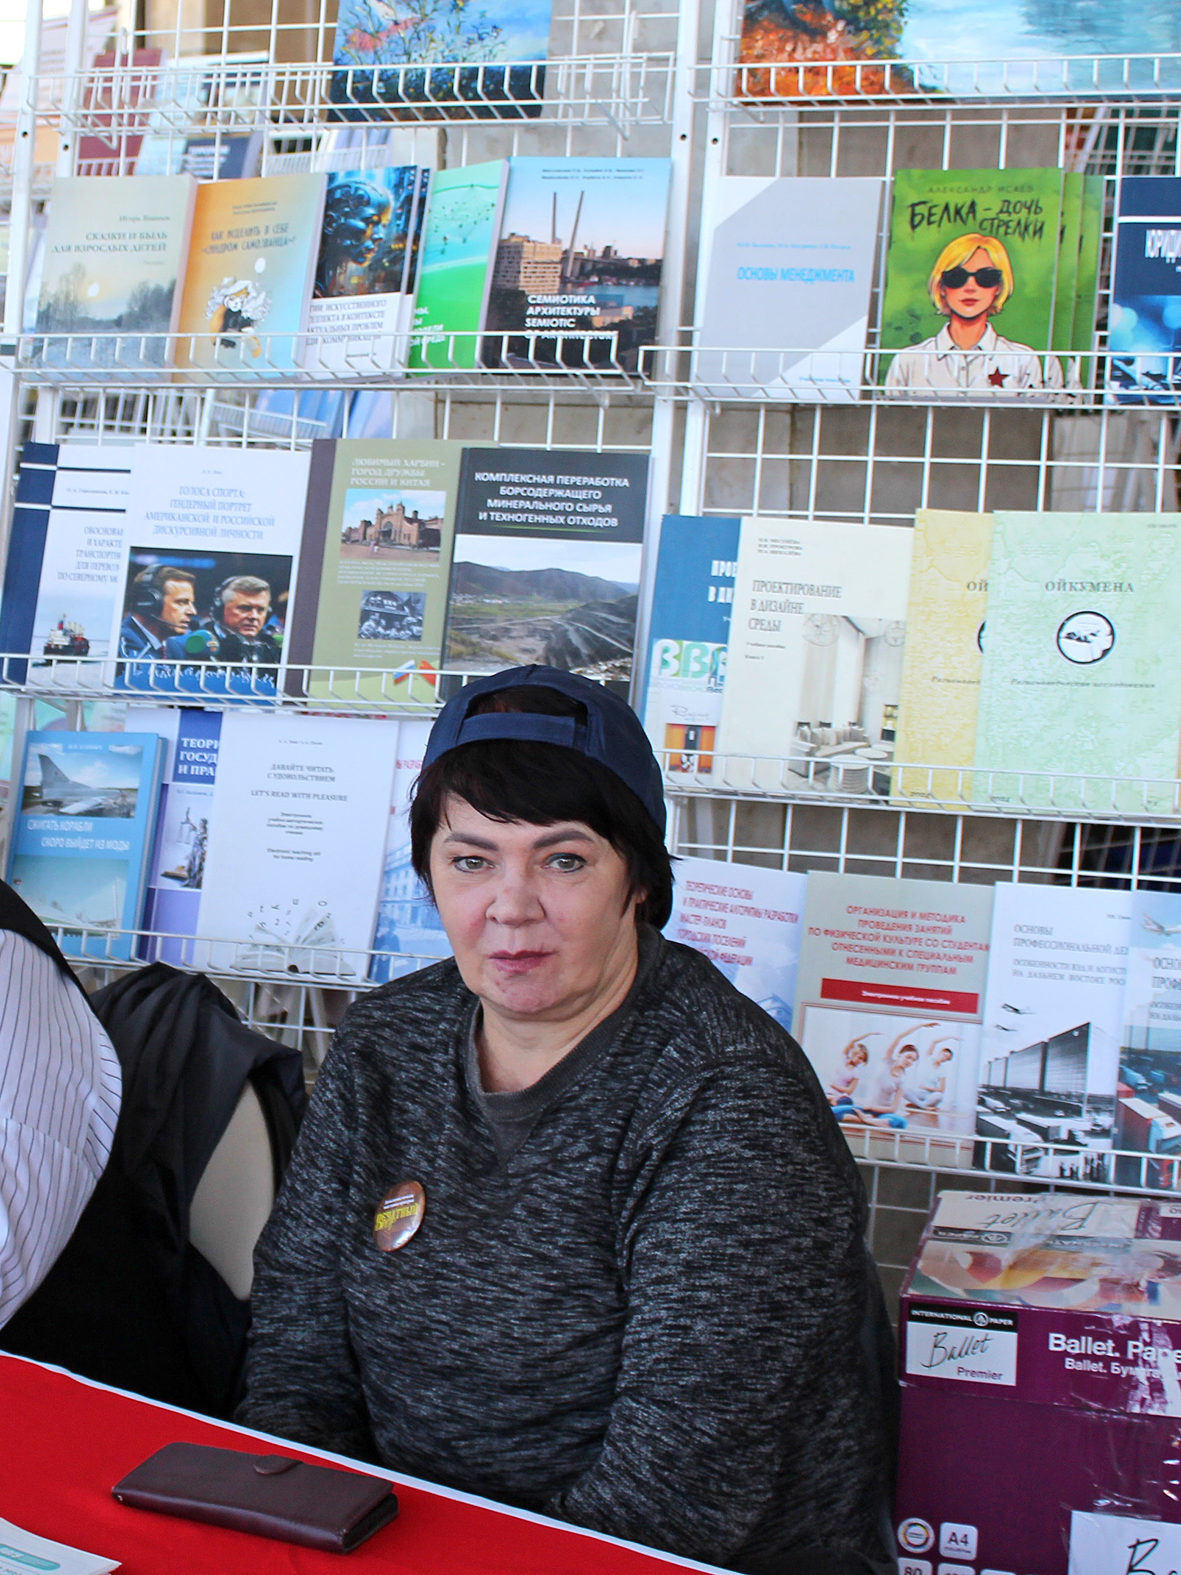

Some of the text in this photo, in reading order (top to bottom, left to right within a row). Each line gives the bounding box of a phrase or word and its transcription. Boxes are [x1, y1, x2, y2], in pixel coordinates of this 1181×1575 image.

[907, 199, 1044, 233] БЕЛКА ДОЧЬ
[979, 216, 1045, 242] СТРЕЛКИ
[85, 232, 126, 241] СКАЗКИ
[131, 241, 167, 253] ДЕТЕЙ
[737, 266, 855, 284] ОСНОВЫ МЕНЕДЖМЕНТА
[527, 295, 596, 304] СЕМИОТИКА
[526, 306, 600, 316] АРХИТЕКТУРЫ
[525, 318, 576, 327] SEMIOTIC
[352, 457, 439, 468] ЛЮБИМЫЙ ХАРБИН
[352, 468, 425, 478] ГОРОД ДРУЖБЫ
[475, 472, 629, 488] КОМПЛЕКСНАЯ ПЕРЕРАБОТКА
[350, 478, 388, 487] РОССИИ
[399, 479, 430, 488] КИТАЯ
[179, 486, 209, 497] ГОЛОСА
[500, 486, 602, 500] БОРСОДЕРЖАЩЕГО
[487, 499, 612, 513] МИНЕРАЛЬНОГО СЫРЬЯ
[479, 512, 618, 528] И ТЕХНОГЕННЫХ ОТХОДОВ
[753, 580, 842, 599] ПРОЕКТИРОВАНИЕ
[1045, 579, 1134, 593] ОЙКУМЕНА
[750, 599, 804, 615] В ДИЗАЙНЕ
[749, 618, 781, 632] СРЕДЫ
[178, 765, 188, 774] И
[271, 763, 334, 773] ДАВАЙТЕ ЧИТАТЬ
[273, 773, 336, 782] УДОВОЛЬСТВИЕМ
[313, 793, 348, 802] PLEASURE
[846, 905, 966, 924] ОРГАНИЗАЦИЯ И МЕТОДИКА
[858, 919, 952, 935] ПРОВЕДЕНИЯ ЗАНЯТИЙ
[1013, 924, 1053, 936] ОСНОВЫ
[808, 926, 939, 948] ПО ФИЗИЧЕСКОЙ КУЛЬТУРЕ СО
[831, 942, 974, 963] ОТНЕСЕННЫМИ К СПЕЦИАЛЬНЫМ
[1013, 937, 1112, 954] ПРОФЕССИОНАЛЬНОЙ
[846, 957, 957, 975] МЕДИЦИНСКИМ ГРУППАМ
[911, 1310, 1013, 1326] INTERNATIONAL PAPER
[920, 1331, 993, 1368] Ballet
[1049, 1333, 1120, 1357] Ballet.
[1065, 1358, 1107, 1373] Ballet.
[957, 1366, 1003, 1380] Premier
[948, 1532, 969, 1547] A4
